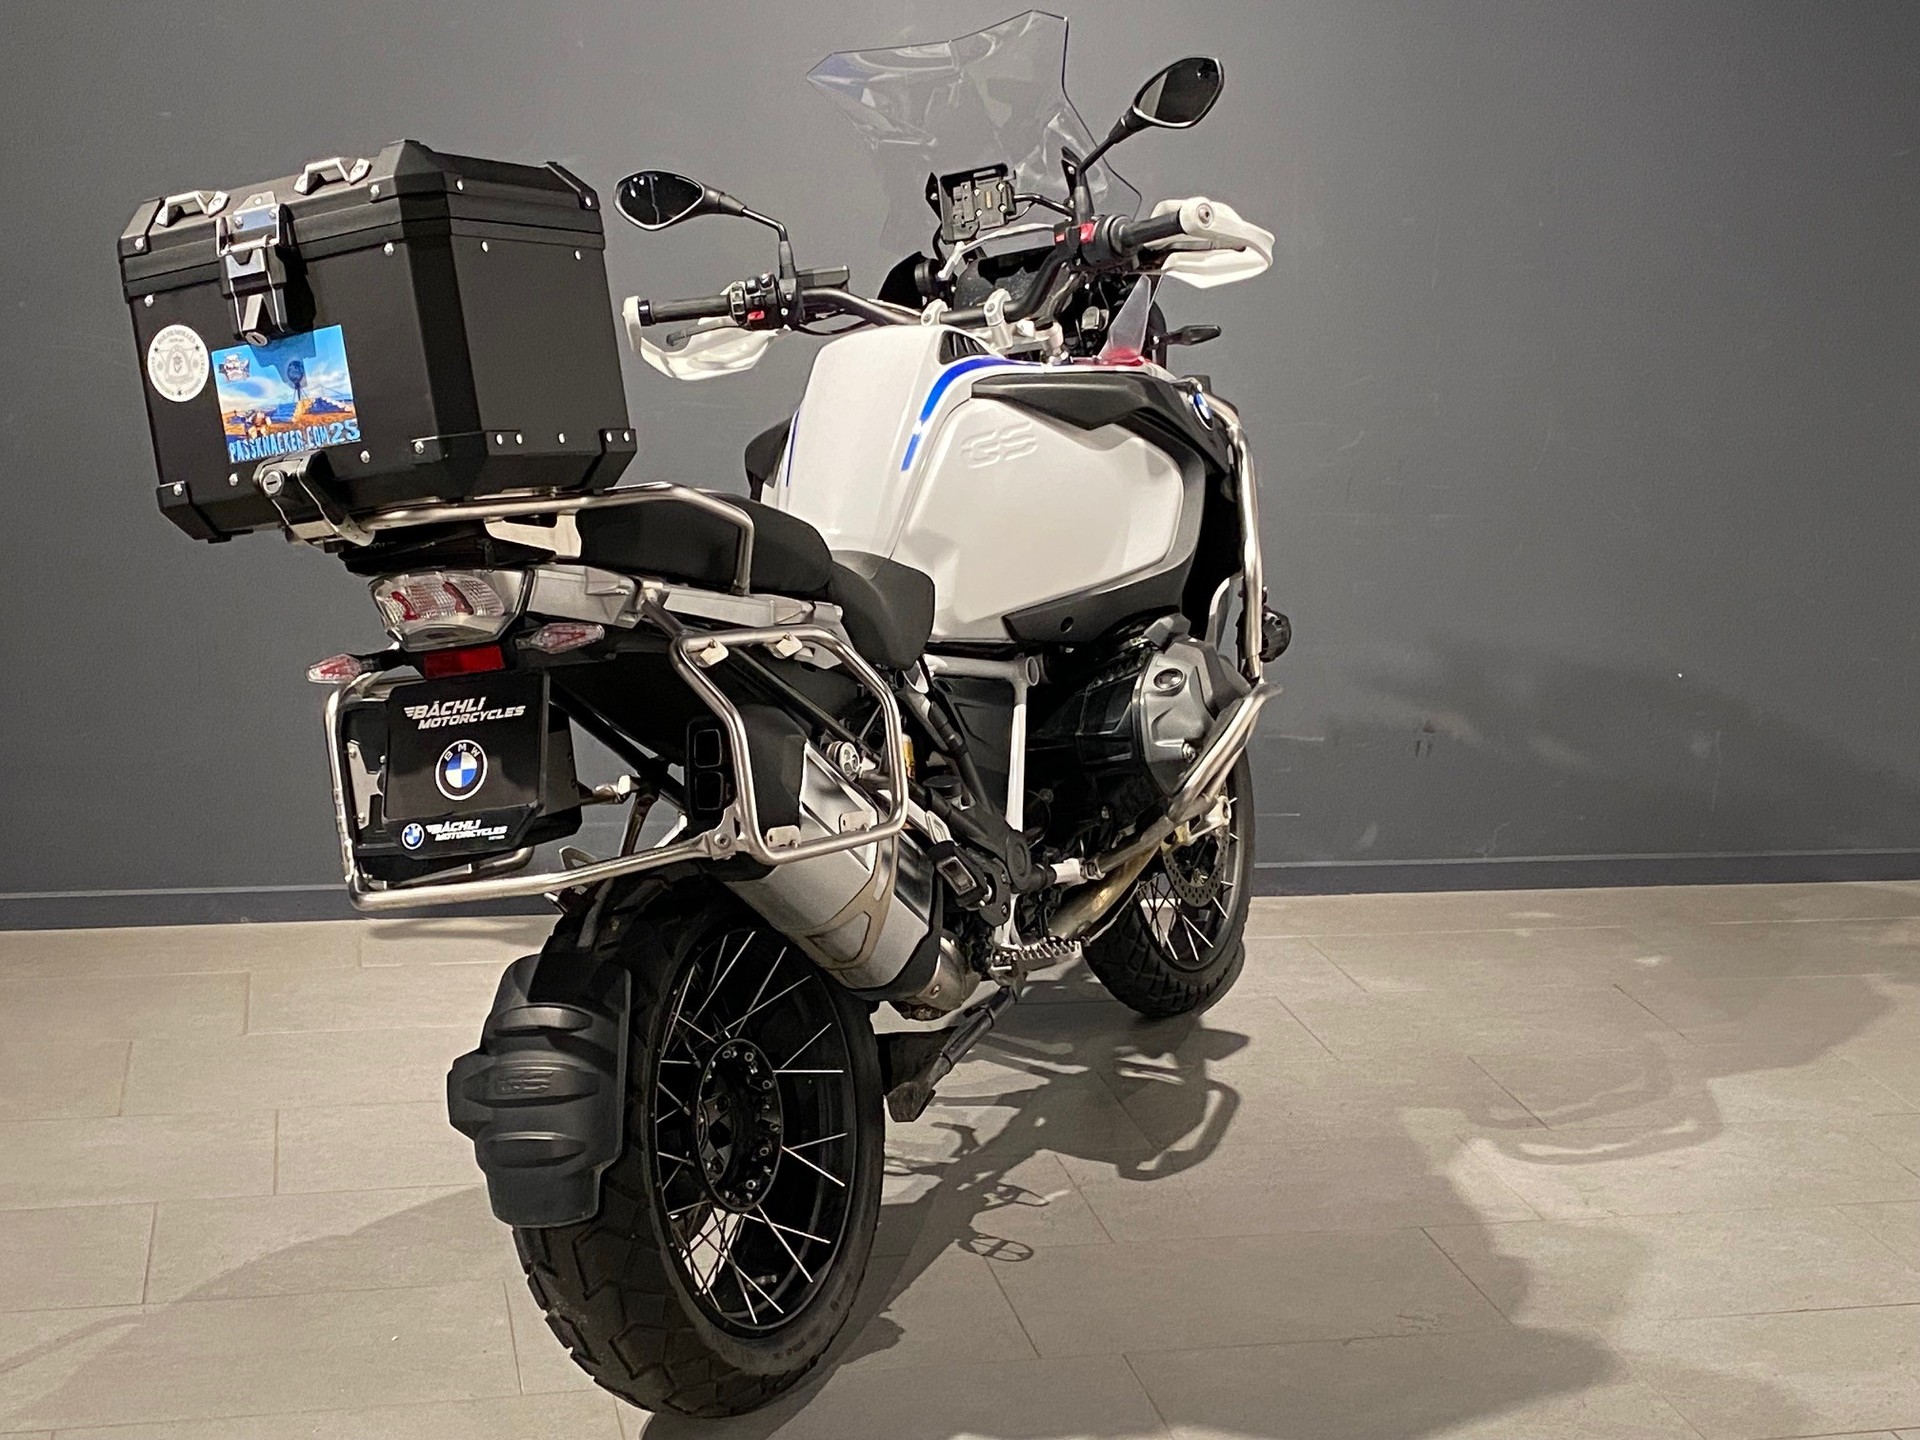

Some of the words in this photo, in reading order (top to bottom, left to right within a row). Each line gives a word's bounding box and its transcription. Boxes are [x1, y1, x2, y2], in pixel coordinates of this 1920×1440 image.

[960, 421, 1037, 469] GS
[417, 705, 526, 730] MOTORCYCLES
[444, 743, 481, 761] BMW
[434, 825, 508, 842] MOTORCYCLES
